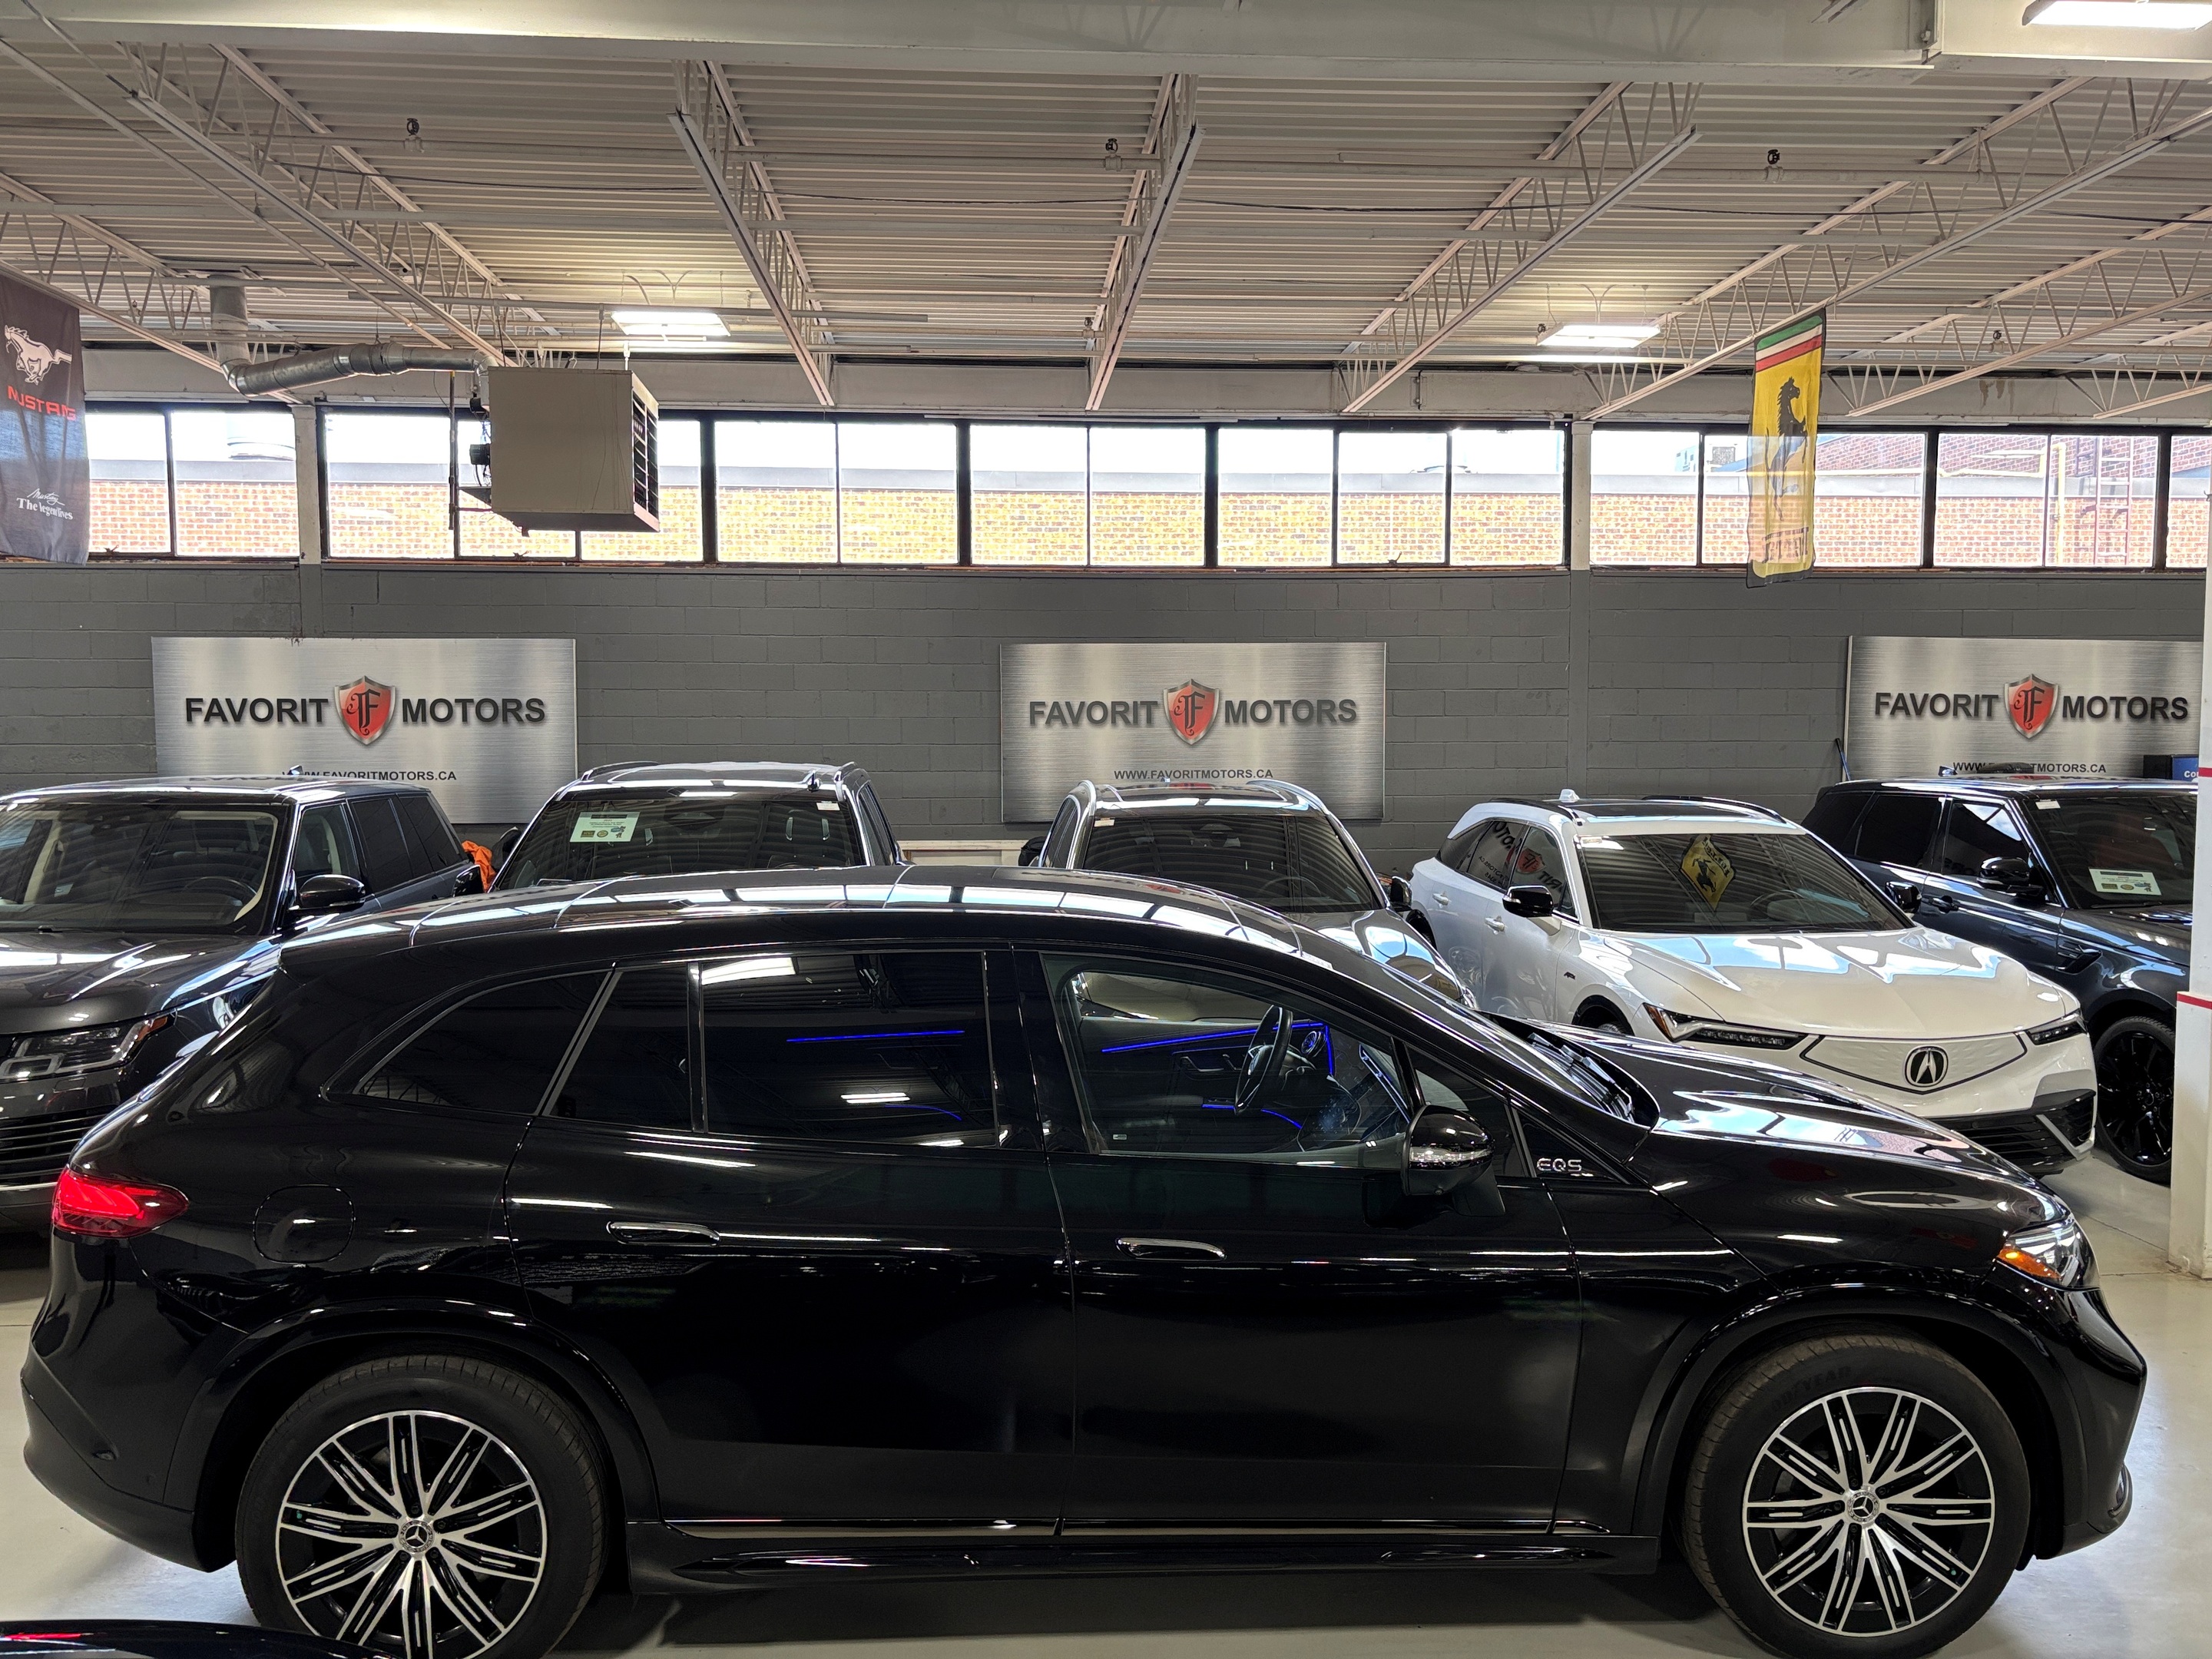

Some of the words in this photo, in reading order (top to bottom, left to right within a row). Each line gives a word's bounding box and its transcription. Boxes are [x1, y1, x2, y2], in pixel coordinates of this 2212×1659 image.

[16, 497, 38, 512] The
[186, 697, 329, 724] FAVORIT
[402, 697, 546, 724] MOTORS
[1029, 700, 1158, 725] FAVORIT
[1225, 699, 1357, 724] MOTORS
[1875, 692, 1999, 718] FAVORIT
[2062, 695, 2189, 720] MOTORS
[1114, 770, 1273, 780] WWW.FAVORITMOTORS.CA
[1536, 1157, 1582, 1172] EQS
